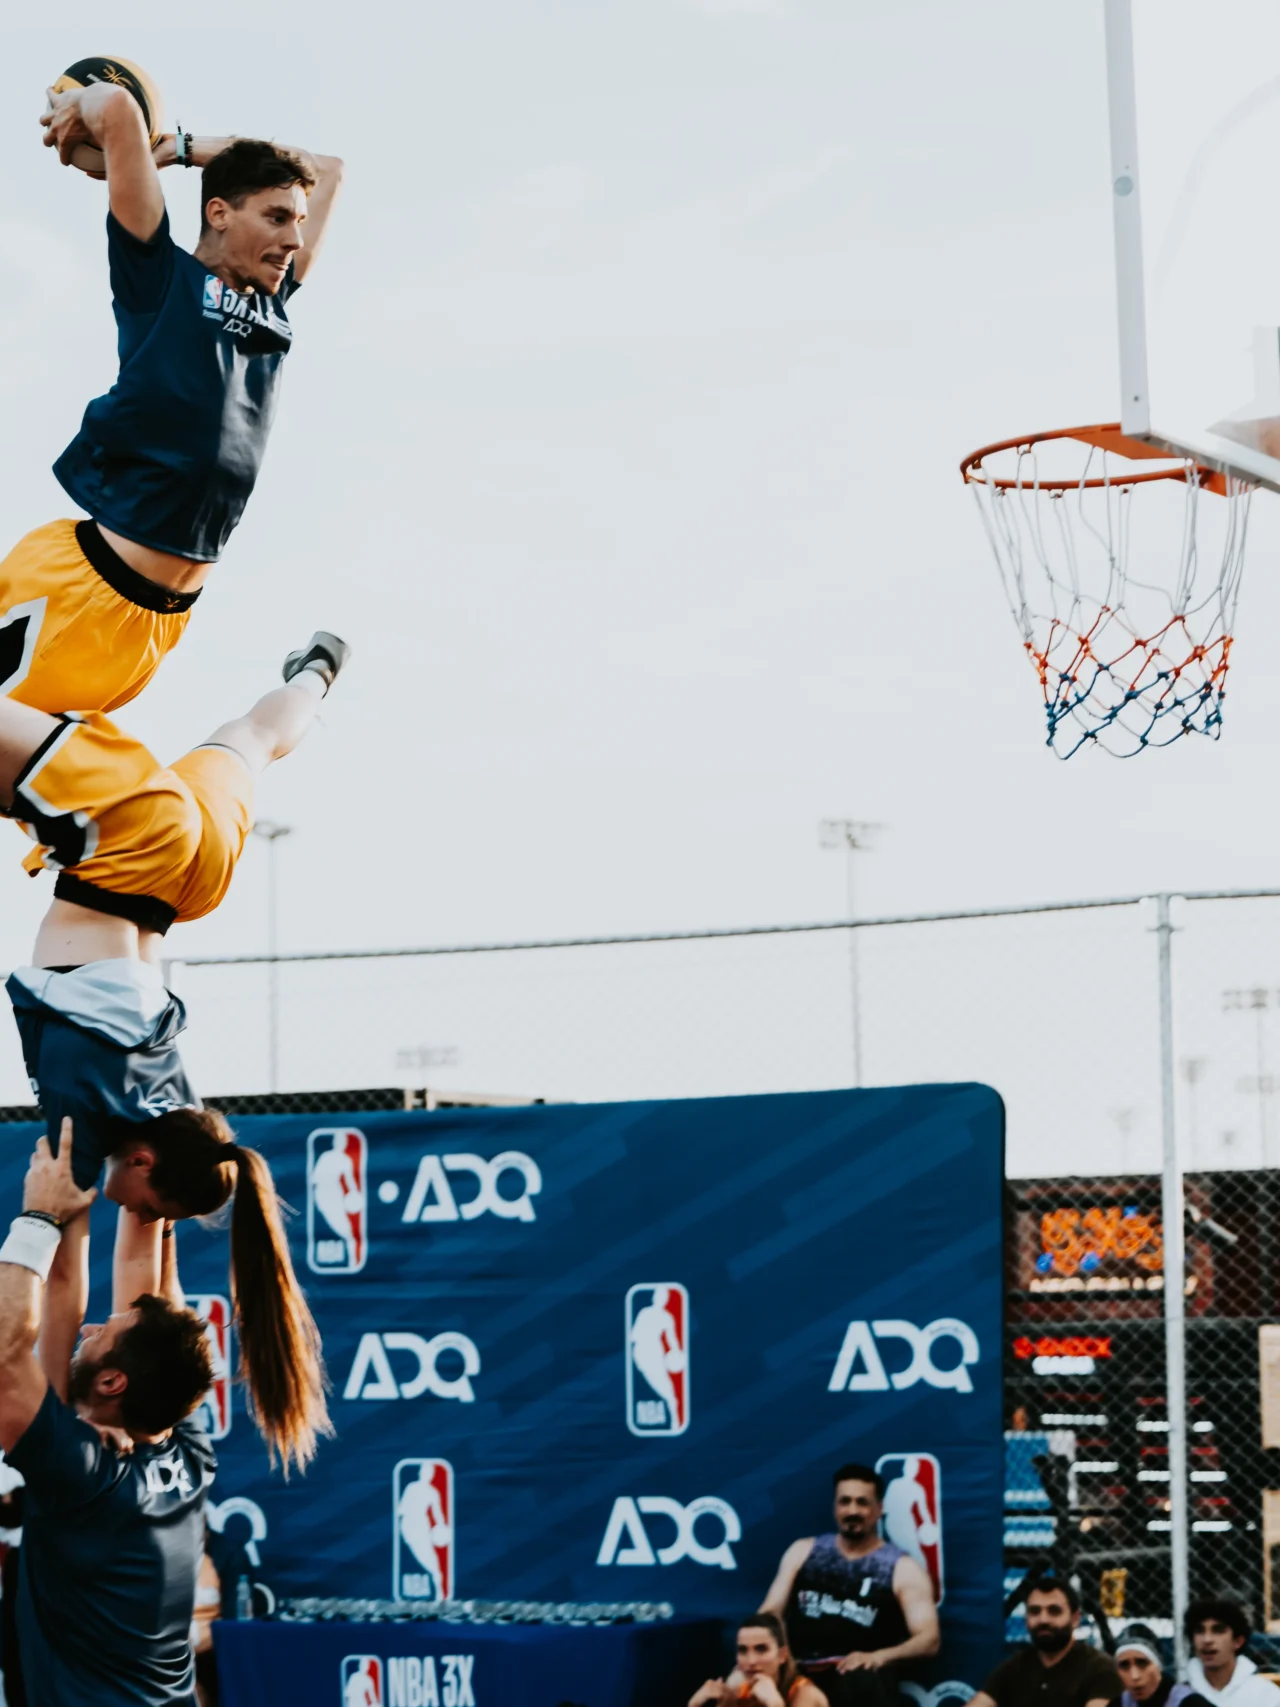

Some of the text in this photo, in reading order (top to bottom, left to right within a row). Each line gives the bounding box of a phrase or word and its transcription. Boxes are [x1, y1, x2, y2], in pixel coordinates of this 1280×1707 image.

[223, 318, 252, 338] ADQ
[401, 1150, 543, 1223] ADQ
[342, 1331, 481, 1404] ADQ
[827, 1317, 980, 1393] ADQ
[595, 1495, 742, 1570] ADQ
[386, 1654, 476, 1707] NBA 3X
